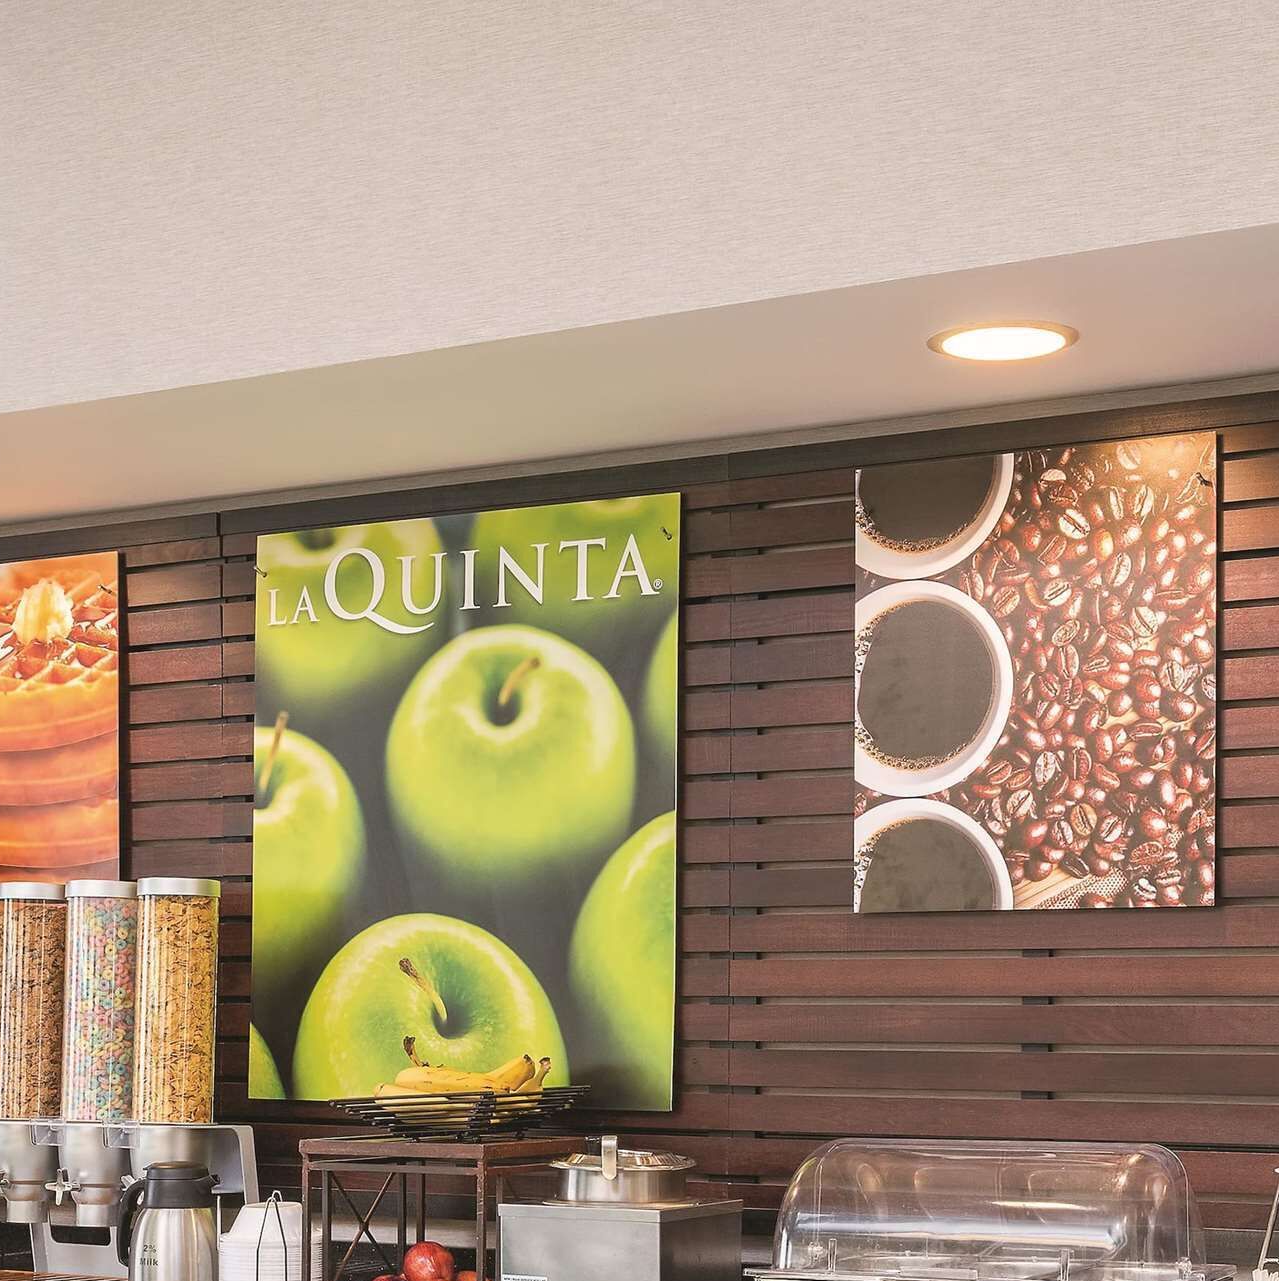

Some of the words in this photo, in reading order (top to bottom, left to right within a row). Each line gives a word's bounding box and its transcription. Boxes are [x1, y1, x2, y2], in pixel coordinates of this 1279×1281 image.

[266, 584, 321, 626] LA
[323, 533, 661, 635] QUINTA
[143, 1244, 157, 1254] 2%
[140, 1258, 158, 1266] Milk
